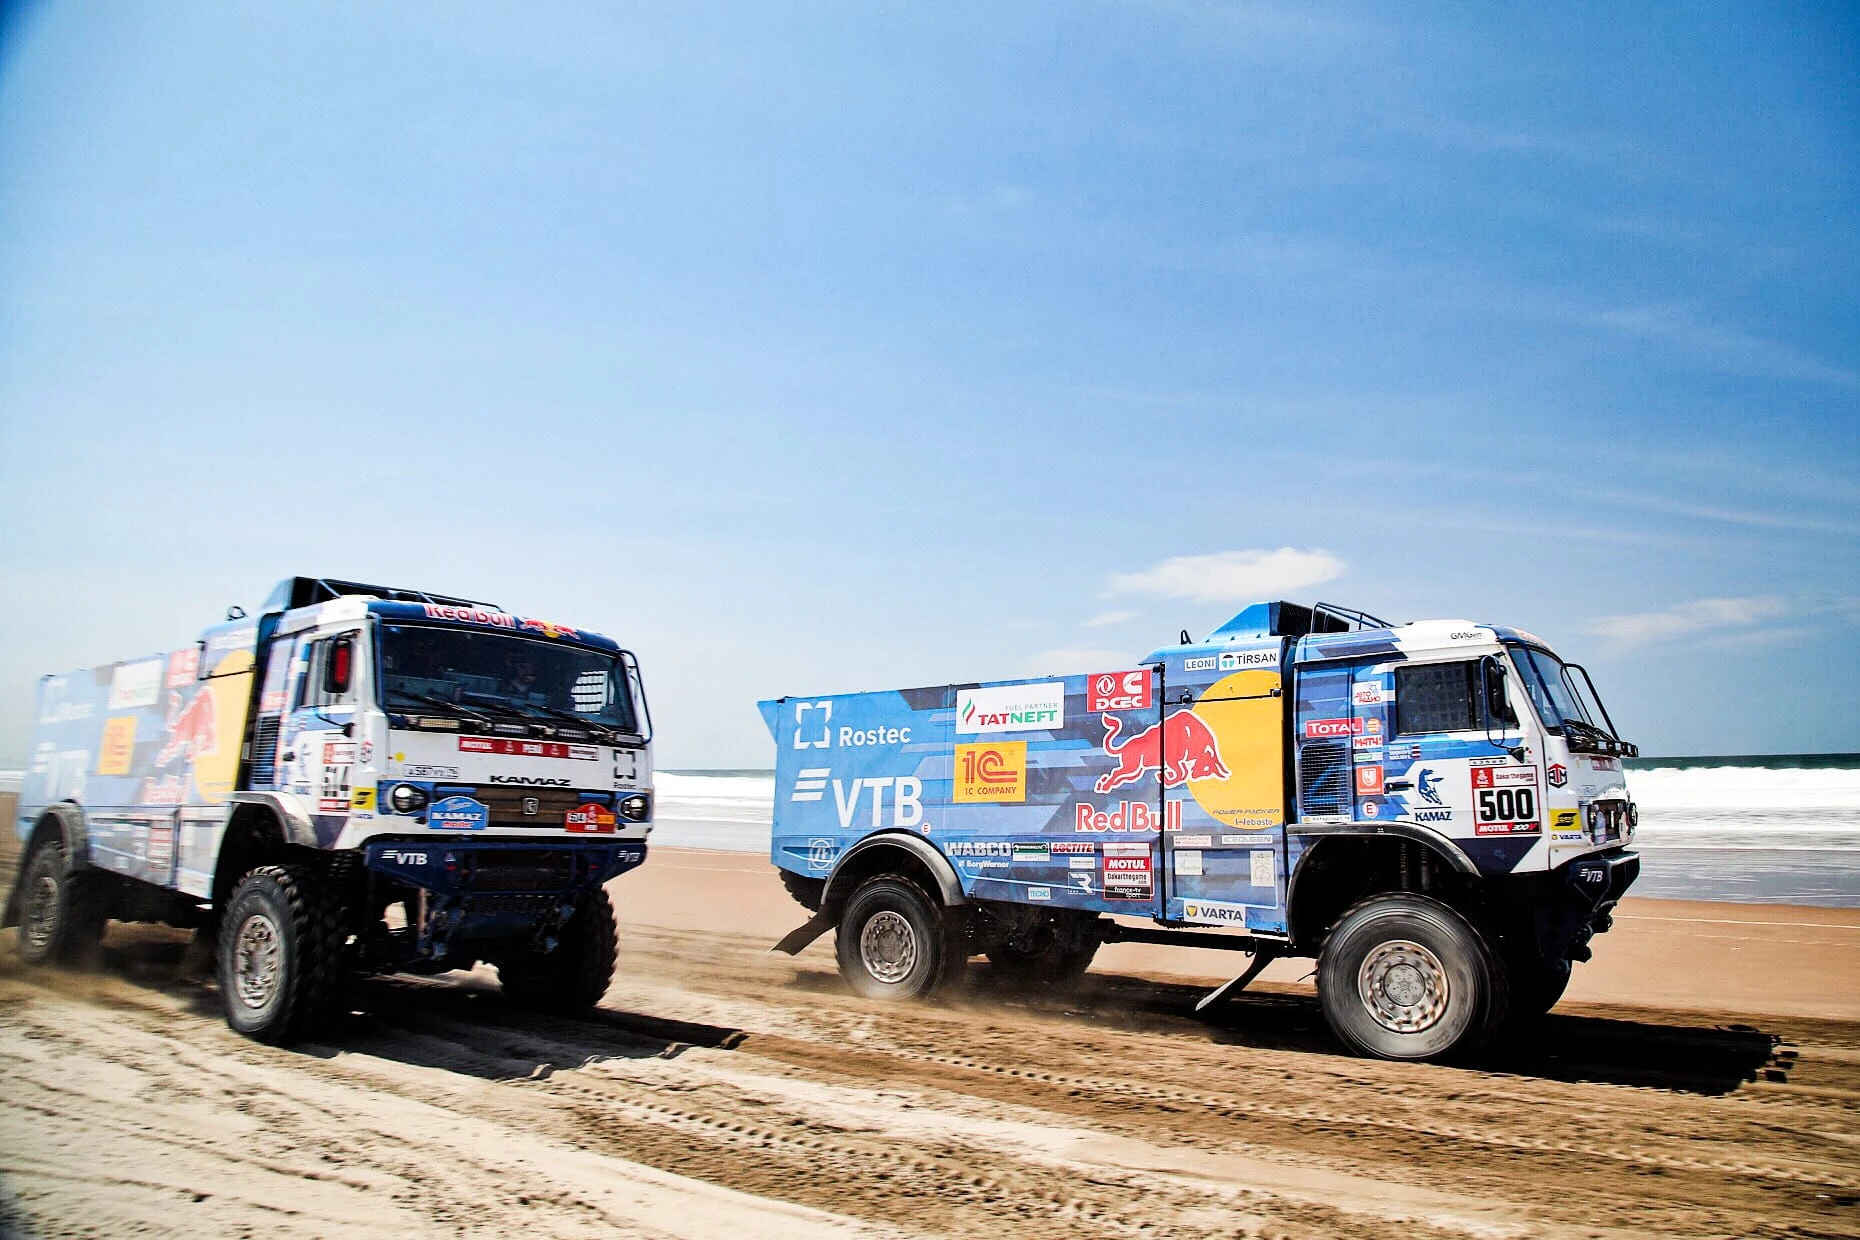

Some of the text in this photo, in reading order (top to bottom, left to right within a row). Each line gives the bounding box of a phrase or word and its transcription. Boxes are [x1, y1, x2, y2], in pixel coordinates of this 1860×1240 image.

[426, 605, 516, 629] Red Bull
[1186, 659, 1214, 669] LEONI
[1024, 702, 1057, 710] PARTNER
[1096, 696, 1142, 710] DCEC
[978, 710, 1057, 725] TATNEFT
[1308, 723, 1360, 734] TOTAL
[840, 725, 912, 747] Rostec
[963, 750, 1017, 784] 1C
[491, 775, 571, 787] KAMAZ
[977, 787, 1016, 795] COMPANY
[832, 776, 923, 828] VTB
[1480, 789, 1534, 821] 500
[432, 812, 482, 820] KAMAZ
[1076, 799, 1183, 832] Red Bull
[1415, 811, 1452, 821] KAMAZ
[944, 842, 1011, 857] WABCO
[1053, 843, 1094, 853] LOCTITE
[396, 853, 428, 865] VTB
[1108, 859, 1146, 869] MOTUL
[1587, 870, 1604, 882] VTB
[1201, 907, 1243, 922] VARTA
